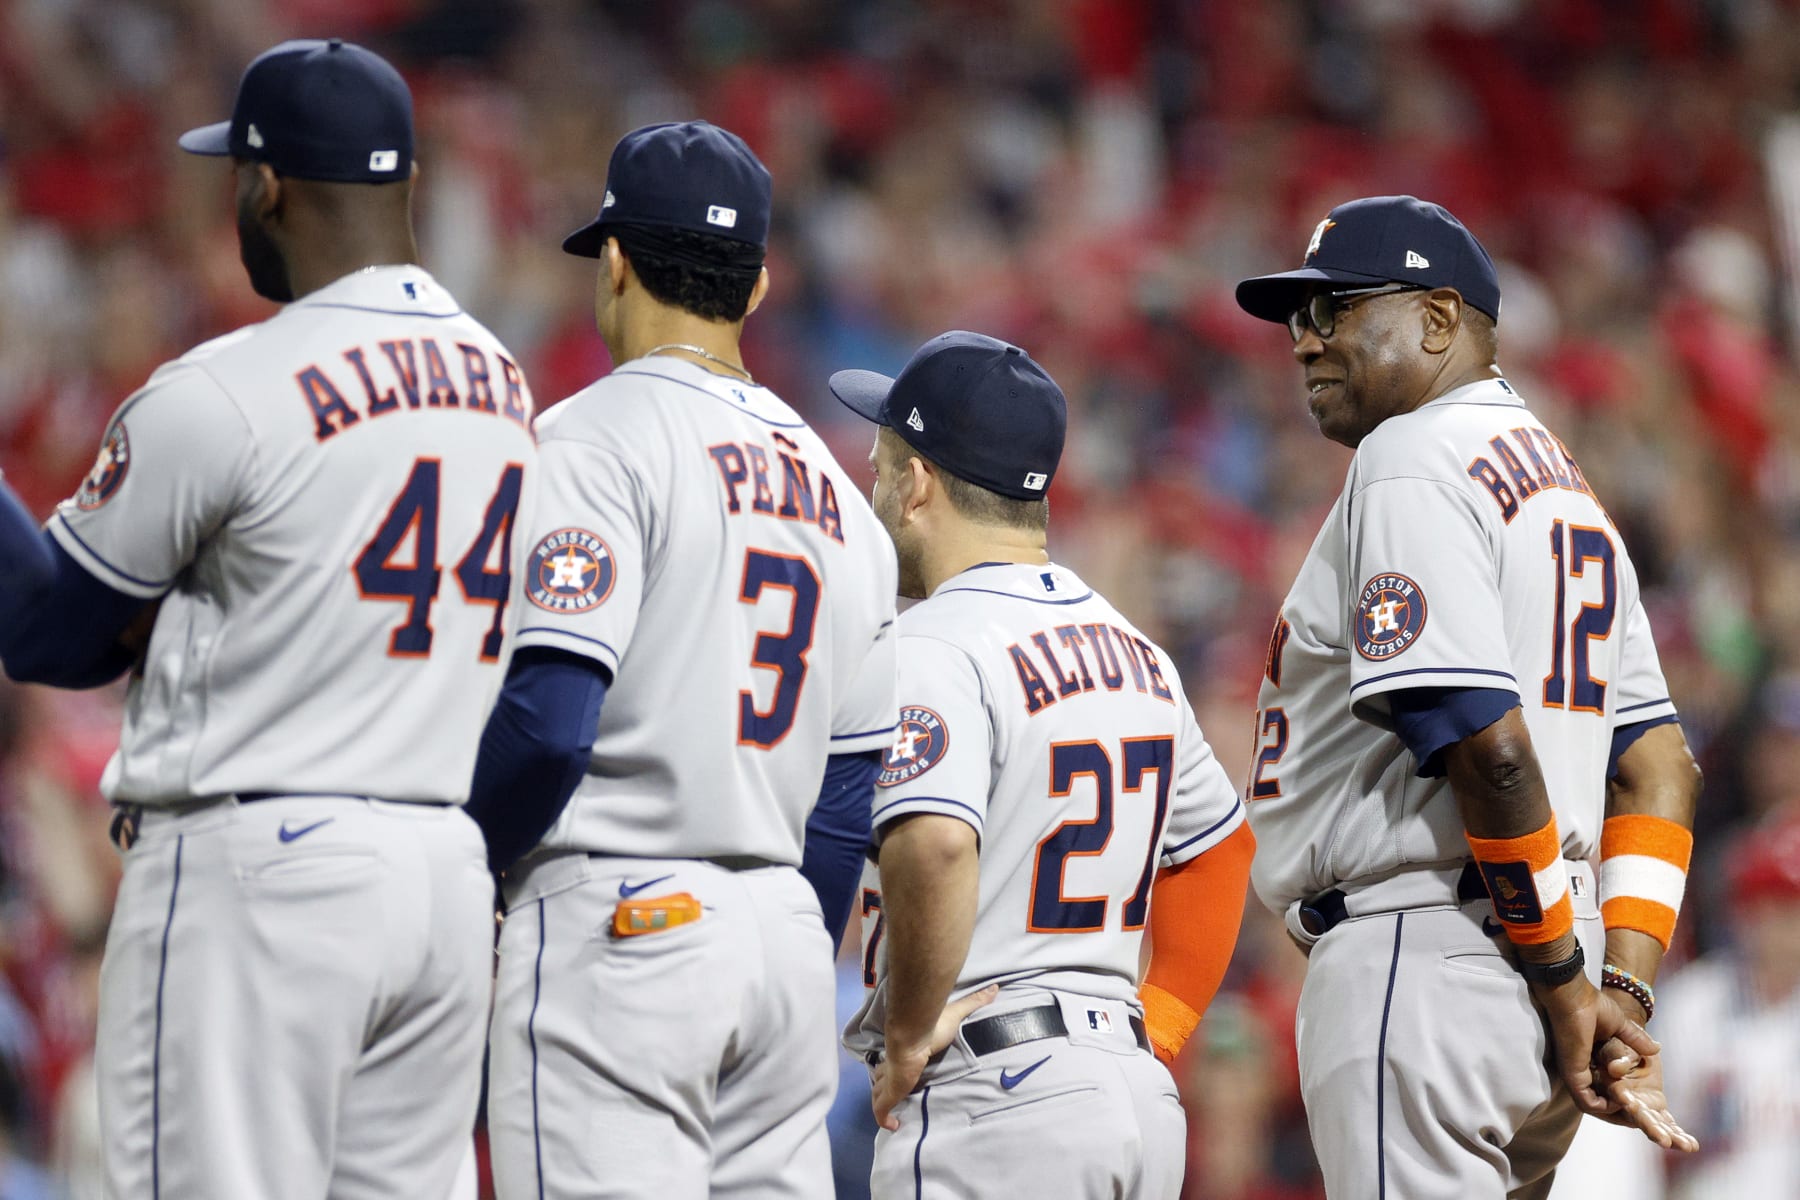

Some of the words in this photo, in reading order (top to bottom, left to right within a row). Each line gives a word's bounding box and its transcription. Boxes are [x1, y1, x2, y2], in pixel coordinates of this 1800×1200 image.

[295, 339, 538, 447] ALVARE
[707, 431, 846, 546] PEÑA
[351, 456, 525, 663] 44
[537, 531, 609, 560] HOUSTON
[533, 588, 599, 611] ASTROS
[1360, 577, 1414, 611] HOUSTON
[1370, 599, 1400, 636] H
[1543, 518, 1617, 716] 12
[737, 546, 823, 751] 3
[1006, 623, 1176, 718] ALTUVE
[1362, 629, 1414, 656] ASTROS
[903, 710, 939, 729] STON
[1026, 734, 1176, 933] 27
